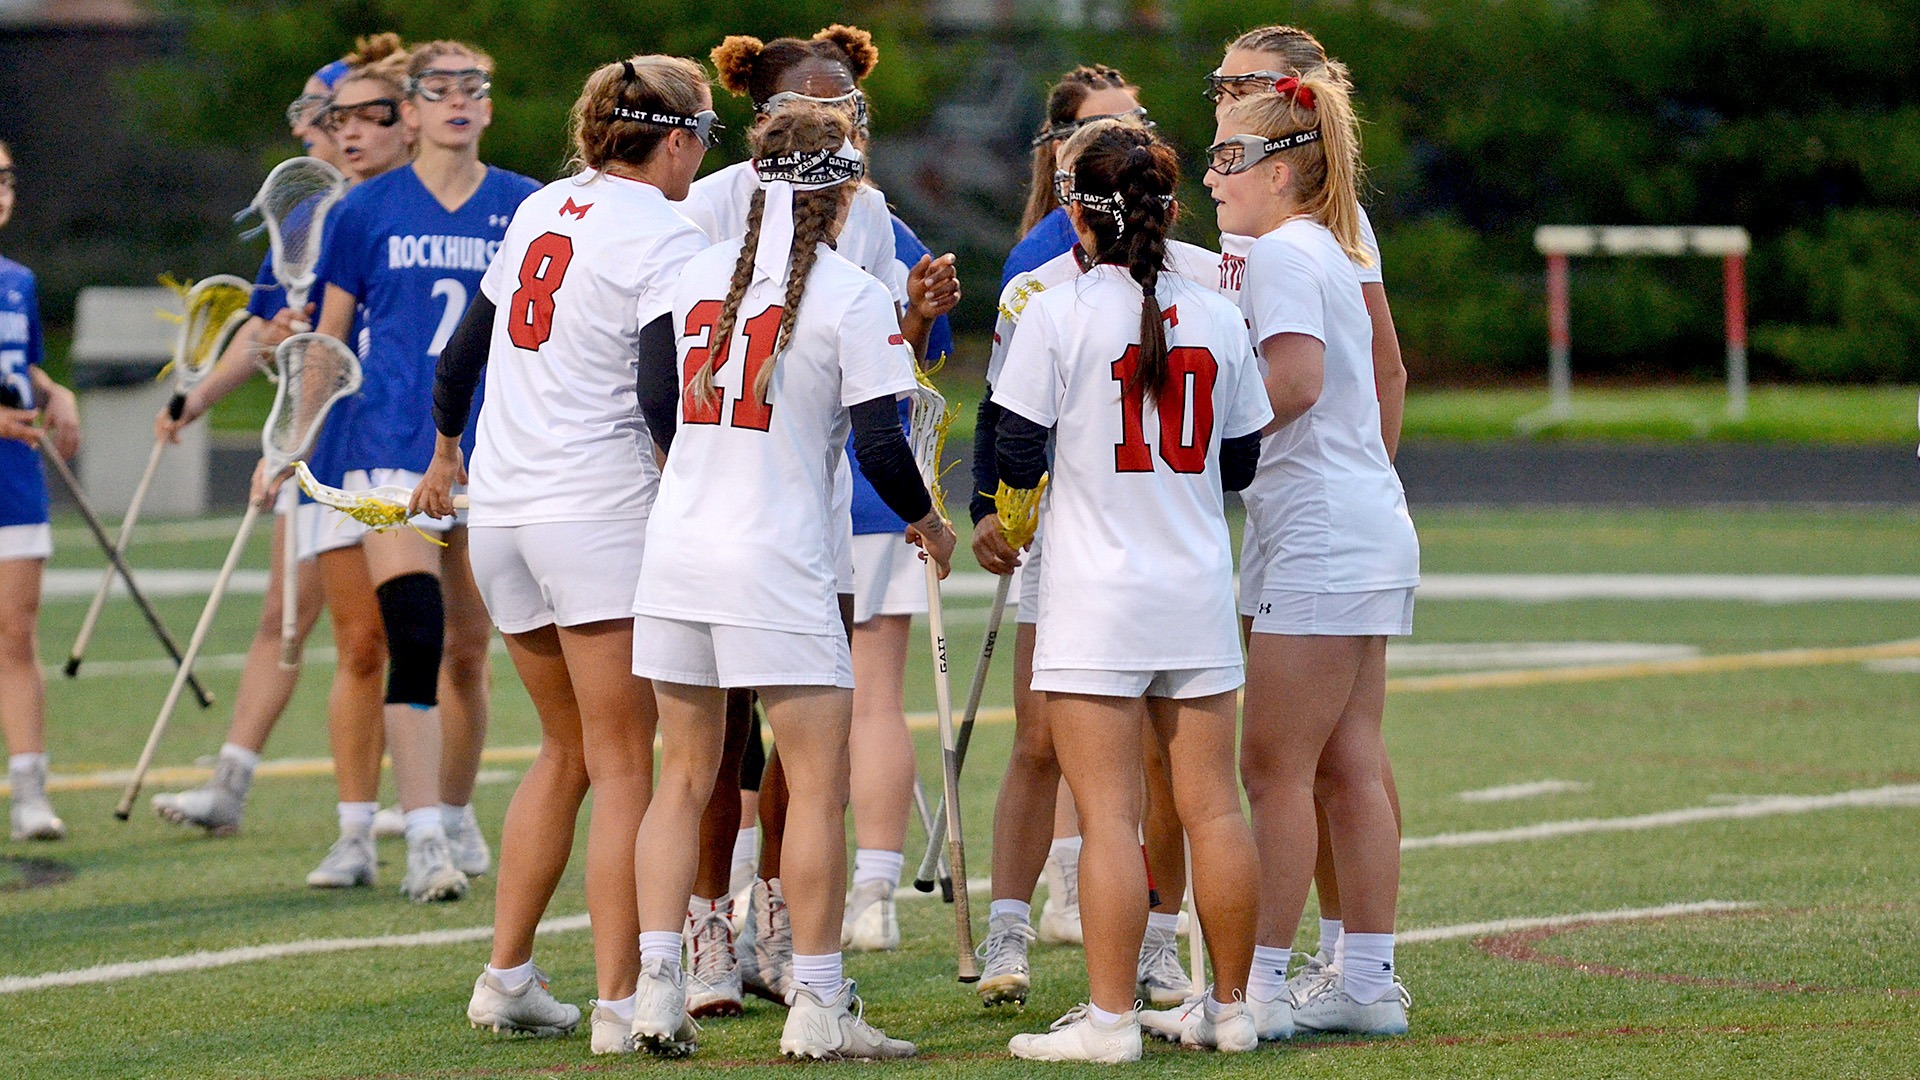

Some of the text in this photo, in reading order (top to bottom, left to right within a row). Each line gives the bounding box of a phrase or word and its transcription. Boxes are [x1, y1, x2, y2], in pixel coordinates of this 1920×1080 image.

[652, 113, 681, 124] GAIT
[684, 117, 698, 127] GA
[1264, 130, 1318, 152] GAIT GAIT
[757, 158, 773, 168] AIT
[828, 156, 850, 169] GAIT
[508, 231, 574, 353] 8
[682, 299, 784, 433] 21
[1110, 342, 1219, 475] 10
[937, 636, 948, 674] GAIT
[984, 630, 998, 659] GAIT
